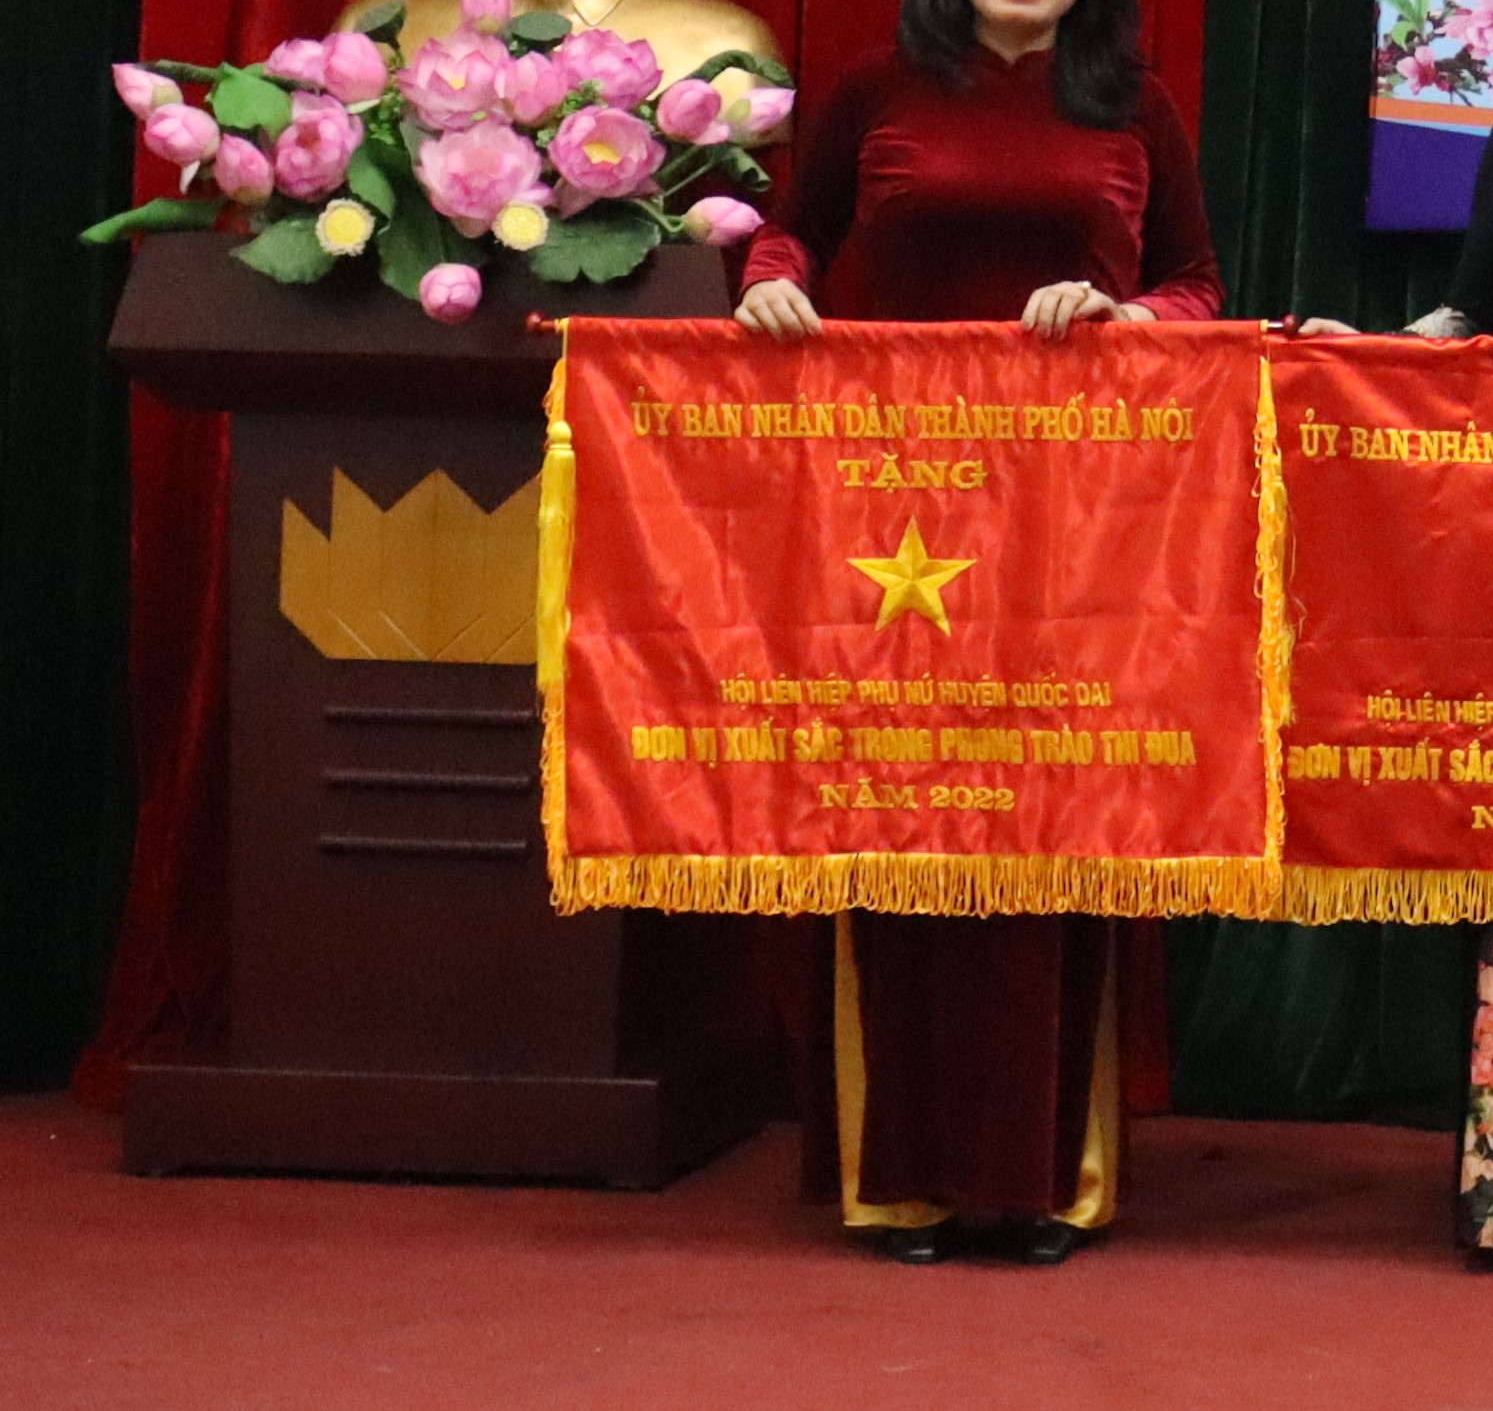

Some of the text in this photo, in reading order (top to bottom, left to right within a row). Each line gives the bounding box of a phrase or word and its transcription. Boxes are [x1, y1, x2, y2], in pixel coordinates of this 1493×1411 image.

[632, 389, 1193, 447] ỦY BAN NHÂN DÂN THÀNH PHỐ HÀ NỘI
[1299, 408, 1340, 457] ỦY
[1350, 427, 1412, 461] BAN
[837, 453, 987, 493] TẶNG
[1367, 691, 1403, 727] HỘI
[1406, 693, 1450, 723] LIÊN
[850, 726, 933, 761] TRONG
[940, 728, 1023, 763] PHONG
[1100, 731, 1139, 764] THI
[1144, 731, 1195, 765] ĐUA
[819, 778, 1014, 810] NĂM 2022
